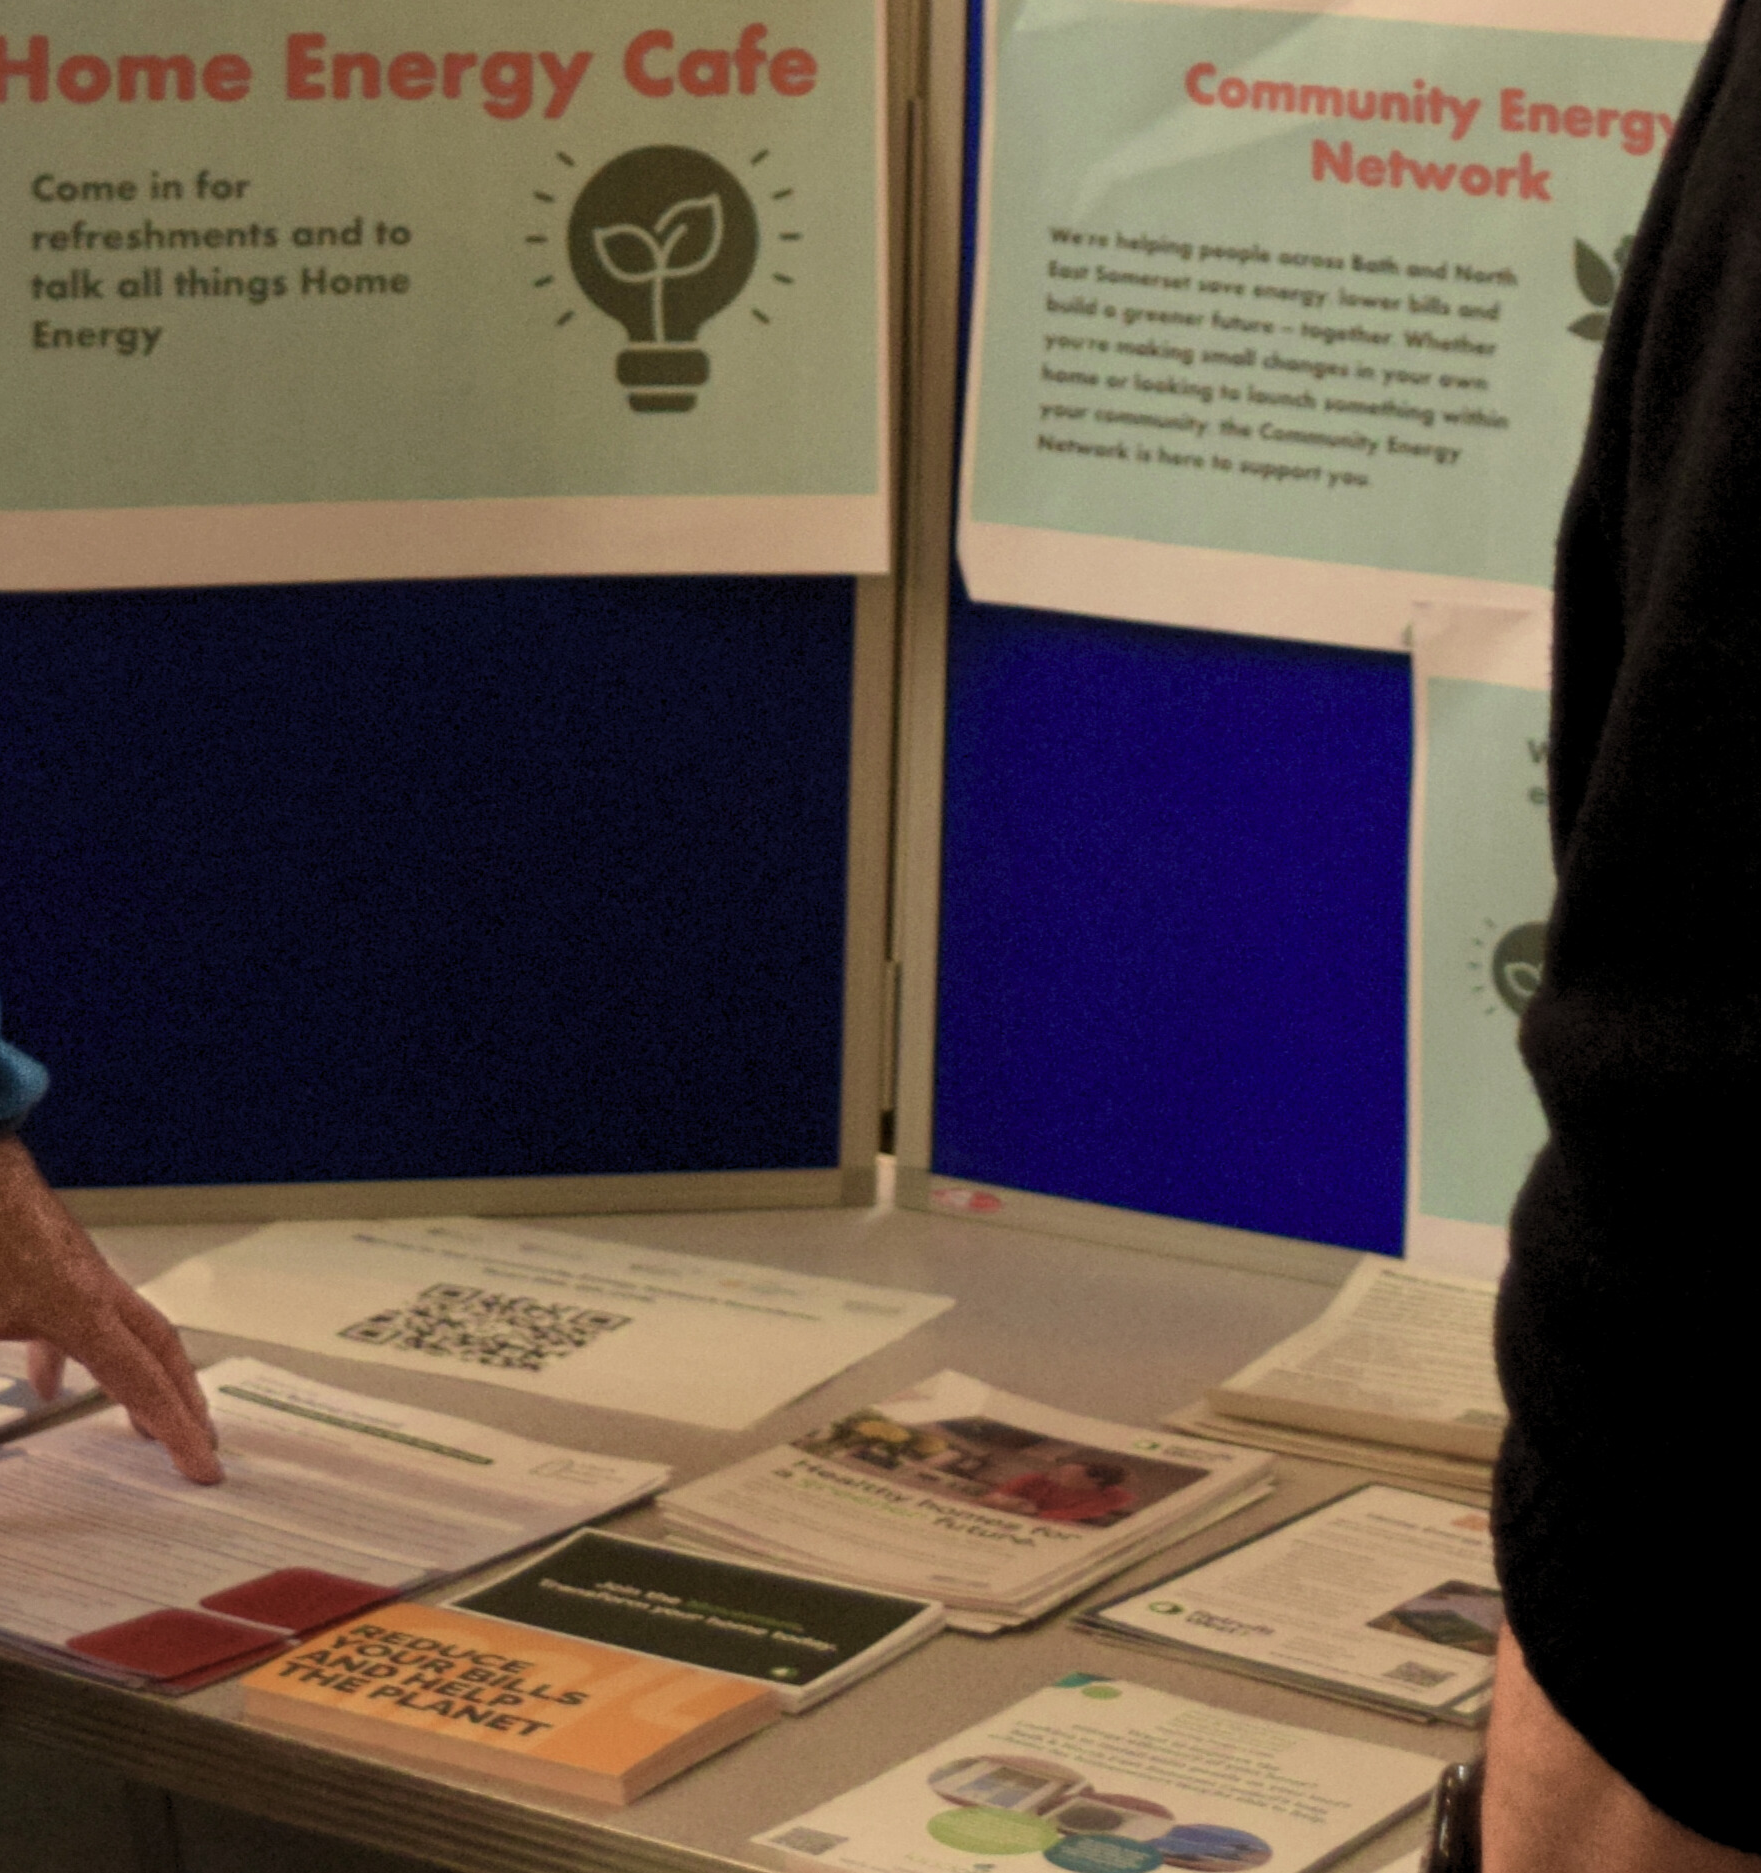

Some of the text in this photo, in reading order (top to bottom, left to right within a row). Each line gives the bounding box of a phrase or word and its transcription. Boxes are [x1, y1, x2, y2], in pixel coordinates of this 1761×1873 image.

[285, 32, 594, 121] Energy
[623, 22, 818, 98] Cafe
[1184, 62, 1482, 141] Community
[32, 168, 250, 206] Come in for
[1311, 138, 1552, 202] Network
[32, 216, 411, 253] refreshments and to
[1116, 231, 1193, 260] helping
[1198, 244, 1270, 264] people
[1279, 252, 1344, 270] across
[1352, 254, 1399, 275] Bath
[1406, 261, 1448, 279] and
[1455, 264, 1518, 285] North
[32, 264, 410, 305] talk all things Home
[1049, 260, 1089, 279] East
[1096, 265, 1191, 289] Somerset
[1198, 280, 1245, 295] save
[1458, 300, 1501, 321] and
[32, 321, 162, 356] Energy
[1046, 292, 1097, 315] build
[1103, 305, 1117, 318] a
[1122, 306, 1204, 326] greener
[1211, 309, 1274, 333] future
[1403, 329, 1497, 356] Whether
[1115, 336, 1194, 365] making
[1201, 347, 1257, 367] small
[1263, 351, 1349, 380] changes
[1383, 369, 1432, 386] your
[1041, 361, 1099, 386] home
[1105, 375, 1127, 388] or
[1133, 374, 1213, 404] looking
[1220, 385, 1240, 401] to
[1247, 384, 1316, 409] launch
[1324, 398, 1435, 427] something
[1037, 433, 1128, 460] Network
[1157, 445, 1205, 468] here
[1212, 454, 1232, 471] to
[1240, 461, 1321, 481] support
[1040, 403, 1089, 421] your
[1220, 414, 1251, 438] the
[1260, 421, 1377, 456] Community
[1386, 435, 1463, 464] Energy
[296, 1649, 524, 1707] AND HELP
[331, 1635, 590, 1707] YOUR BILLS
[350, 1623, 535, 1675] REDUCE
[279, 1660, 554, 1737] THE PLANET
